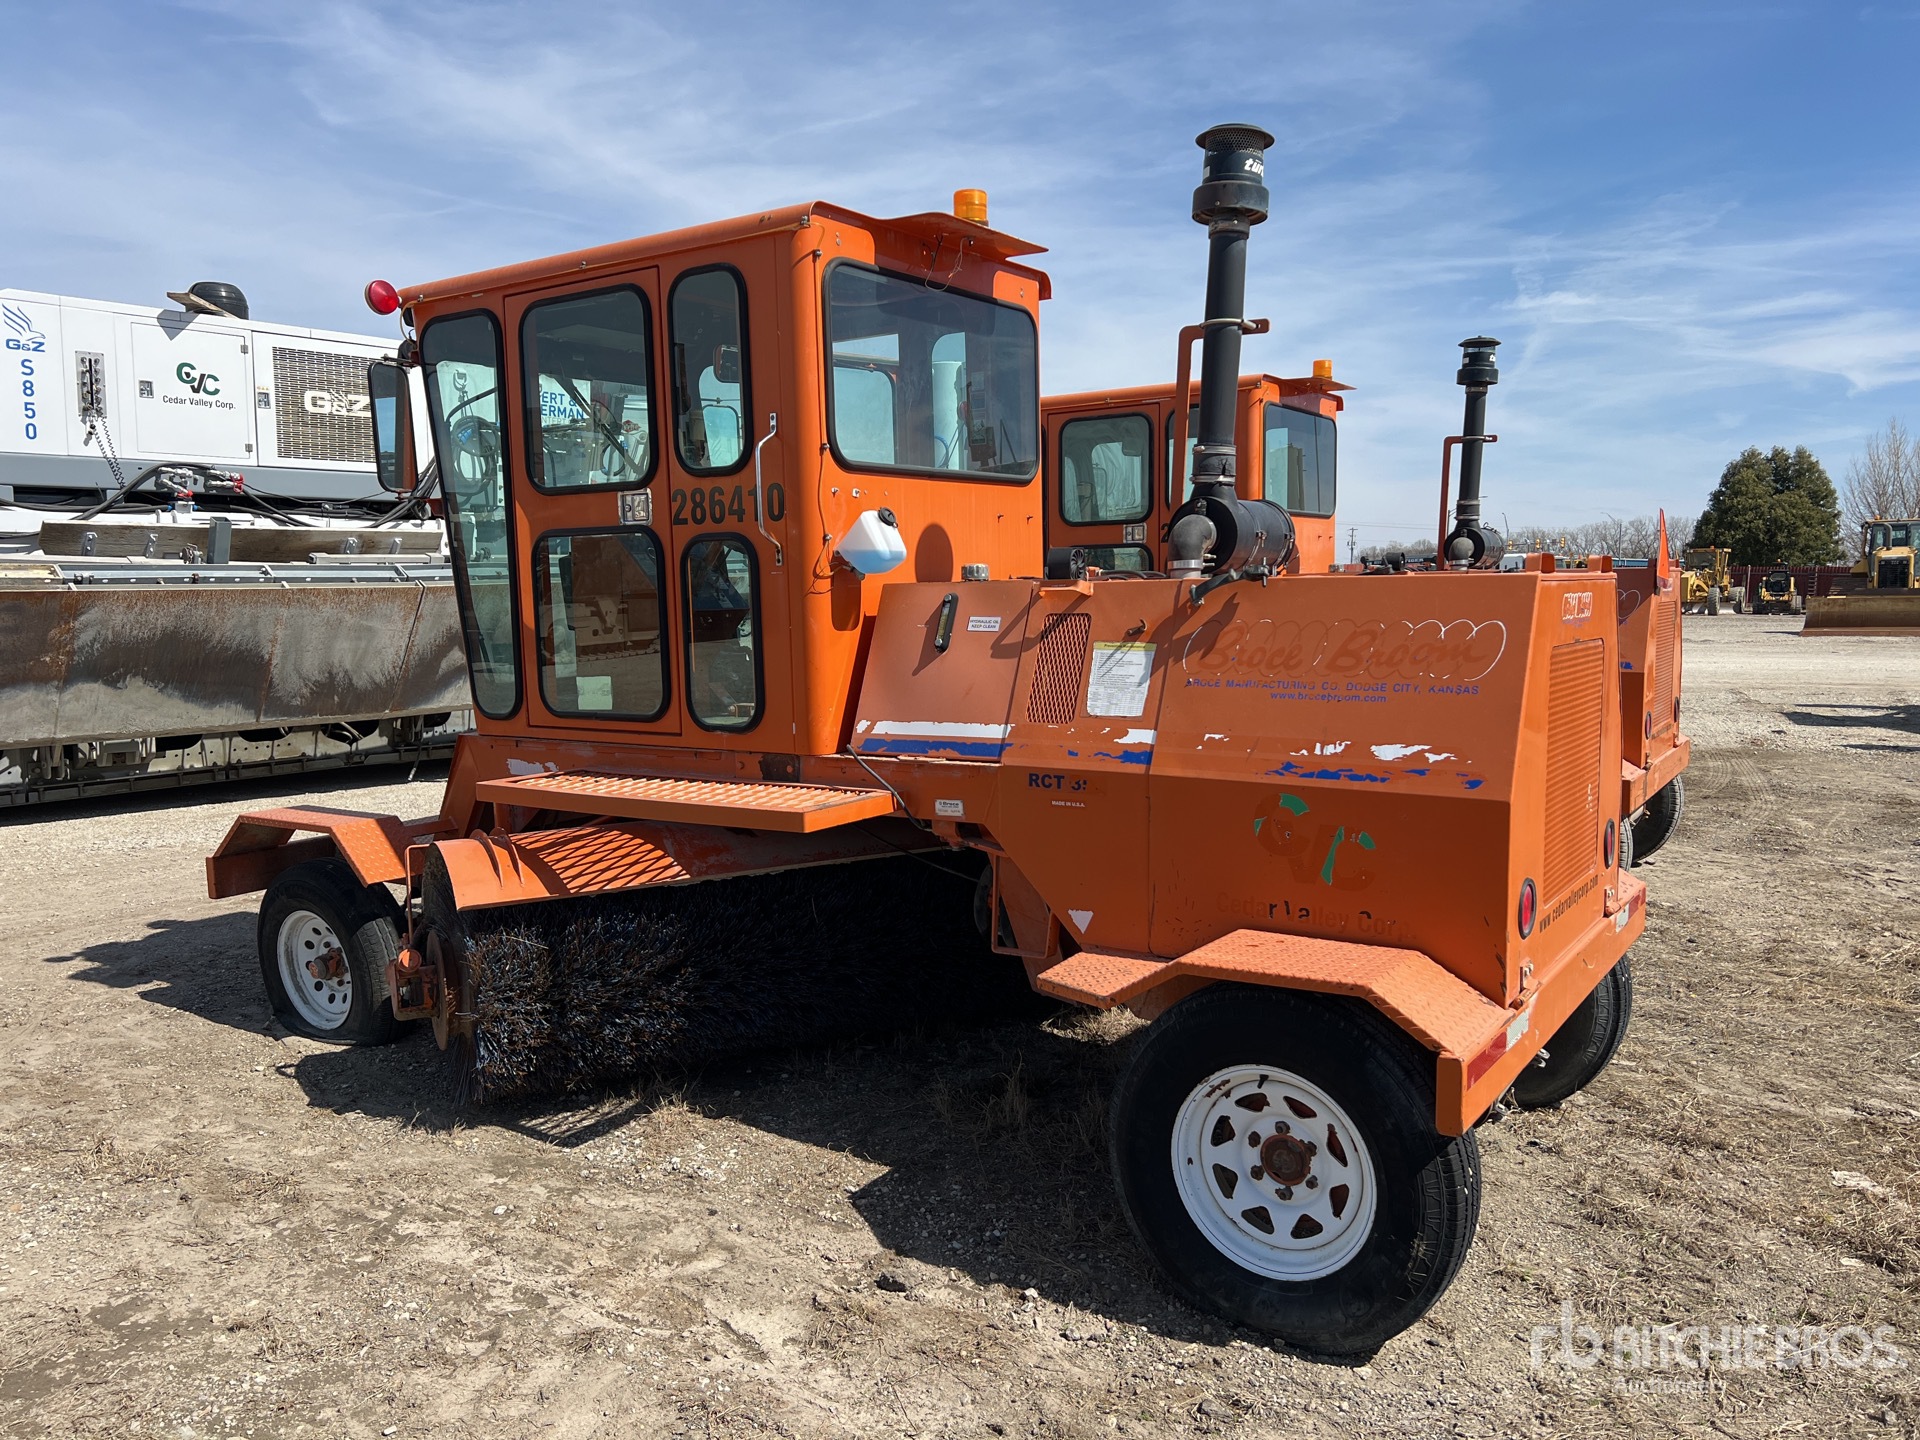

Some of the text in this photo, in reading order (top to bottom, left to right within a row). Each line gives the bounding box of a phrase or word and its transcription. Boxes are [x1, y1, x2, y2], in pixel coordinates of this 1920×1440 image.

[5, 338, 46, 352] G&Z
[162, 395, 237, 411] Cedar Valley Corp.
[671, 482, 785, 526] 286410
[1428, 685, 1480, 696] KANSAS
[1028, 772, 1066, 790] RCT
